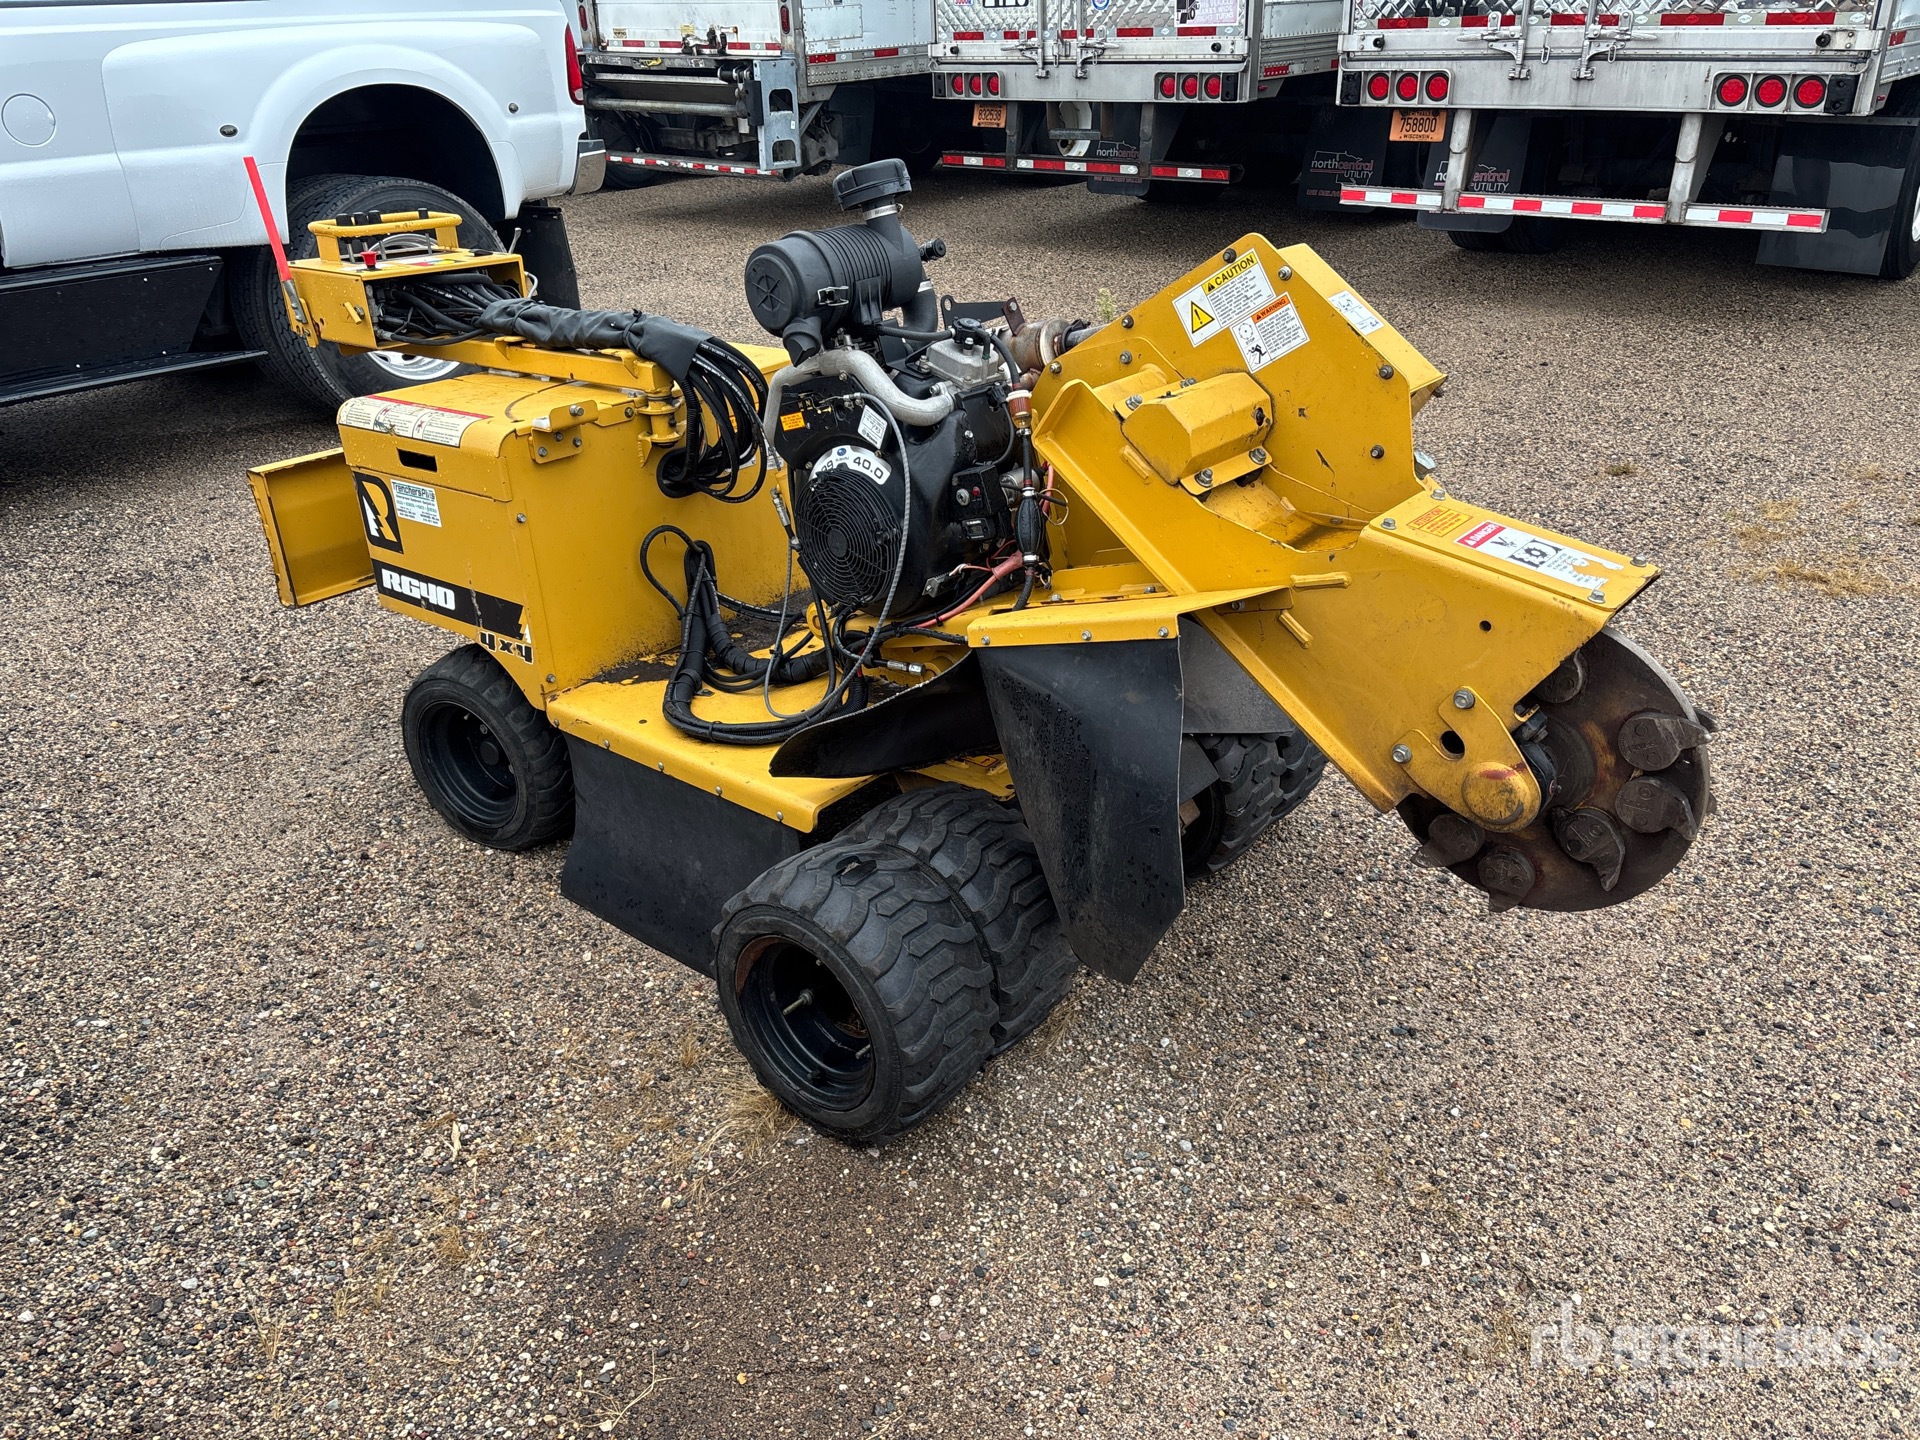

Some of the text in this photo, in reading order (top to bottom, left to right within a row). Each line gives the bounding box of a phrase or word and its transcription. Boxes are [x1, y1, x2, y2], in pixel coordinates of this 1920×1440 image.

[978, 108, 1002, 121] 832538
[1400, 117, 1437, 133] 758800
[1343, 170, 1374, 179] UTILITY
[1473, 182, 1510, 192] UTILITY
[1214, 255, 1254, 286] CAUTION
[1260, 298, 1286, 317] WARNING
[853, 456, 884, 480] 40.0
[1471, 523, 1500, 543] DANGER
